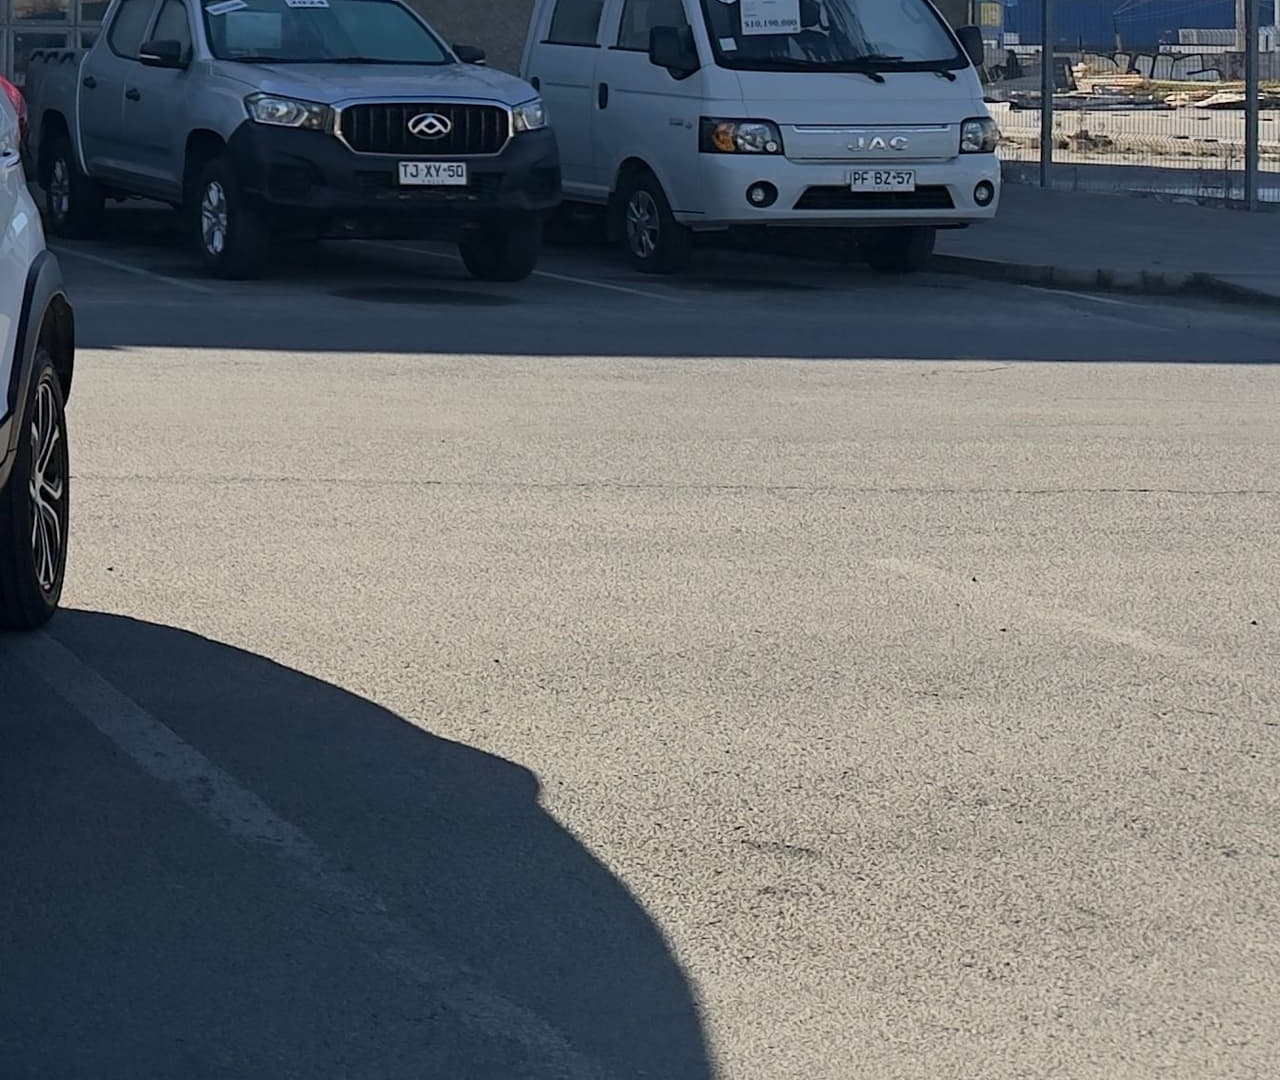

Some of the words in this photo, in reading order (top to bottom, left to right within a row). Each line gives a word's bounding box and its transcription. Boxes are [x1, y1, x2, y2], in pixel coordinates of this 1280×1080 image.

[847, 136, 909, 152] JAC
[401, 164, 419, 178] TJ
[853, 171, 869, 185] PF
